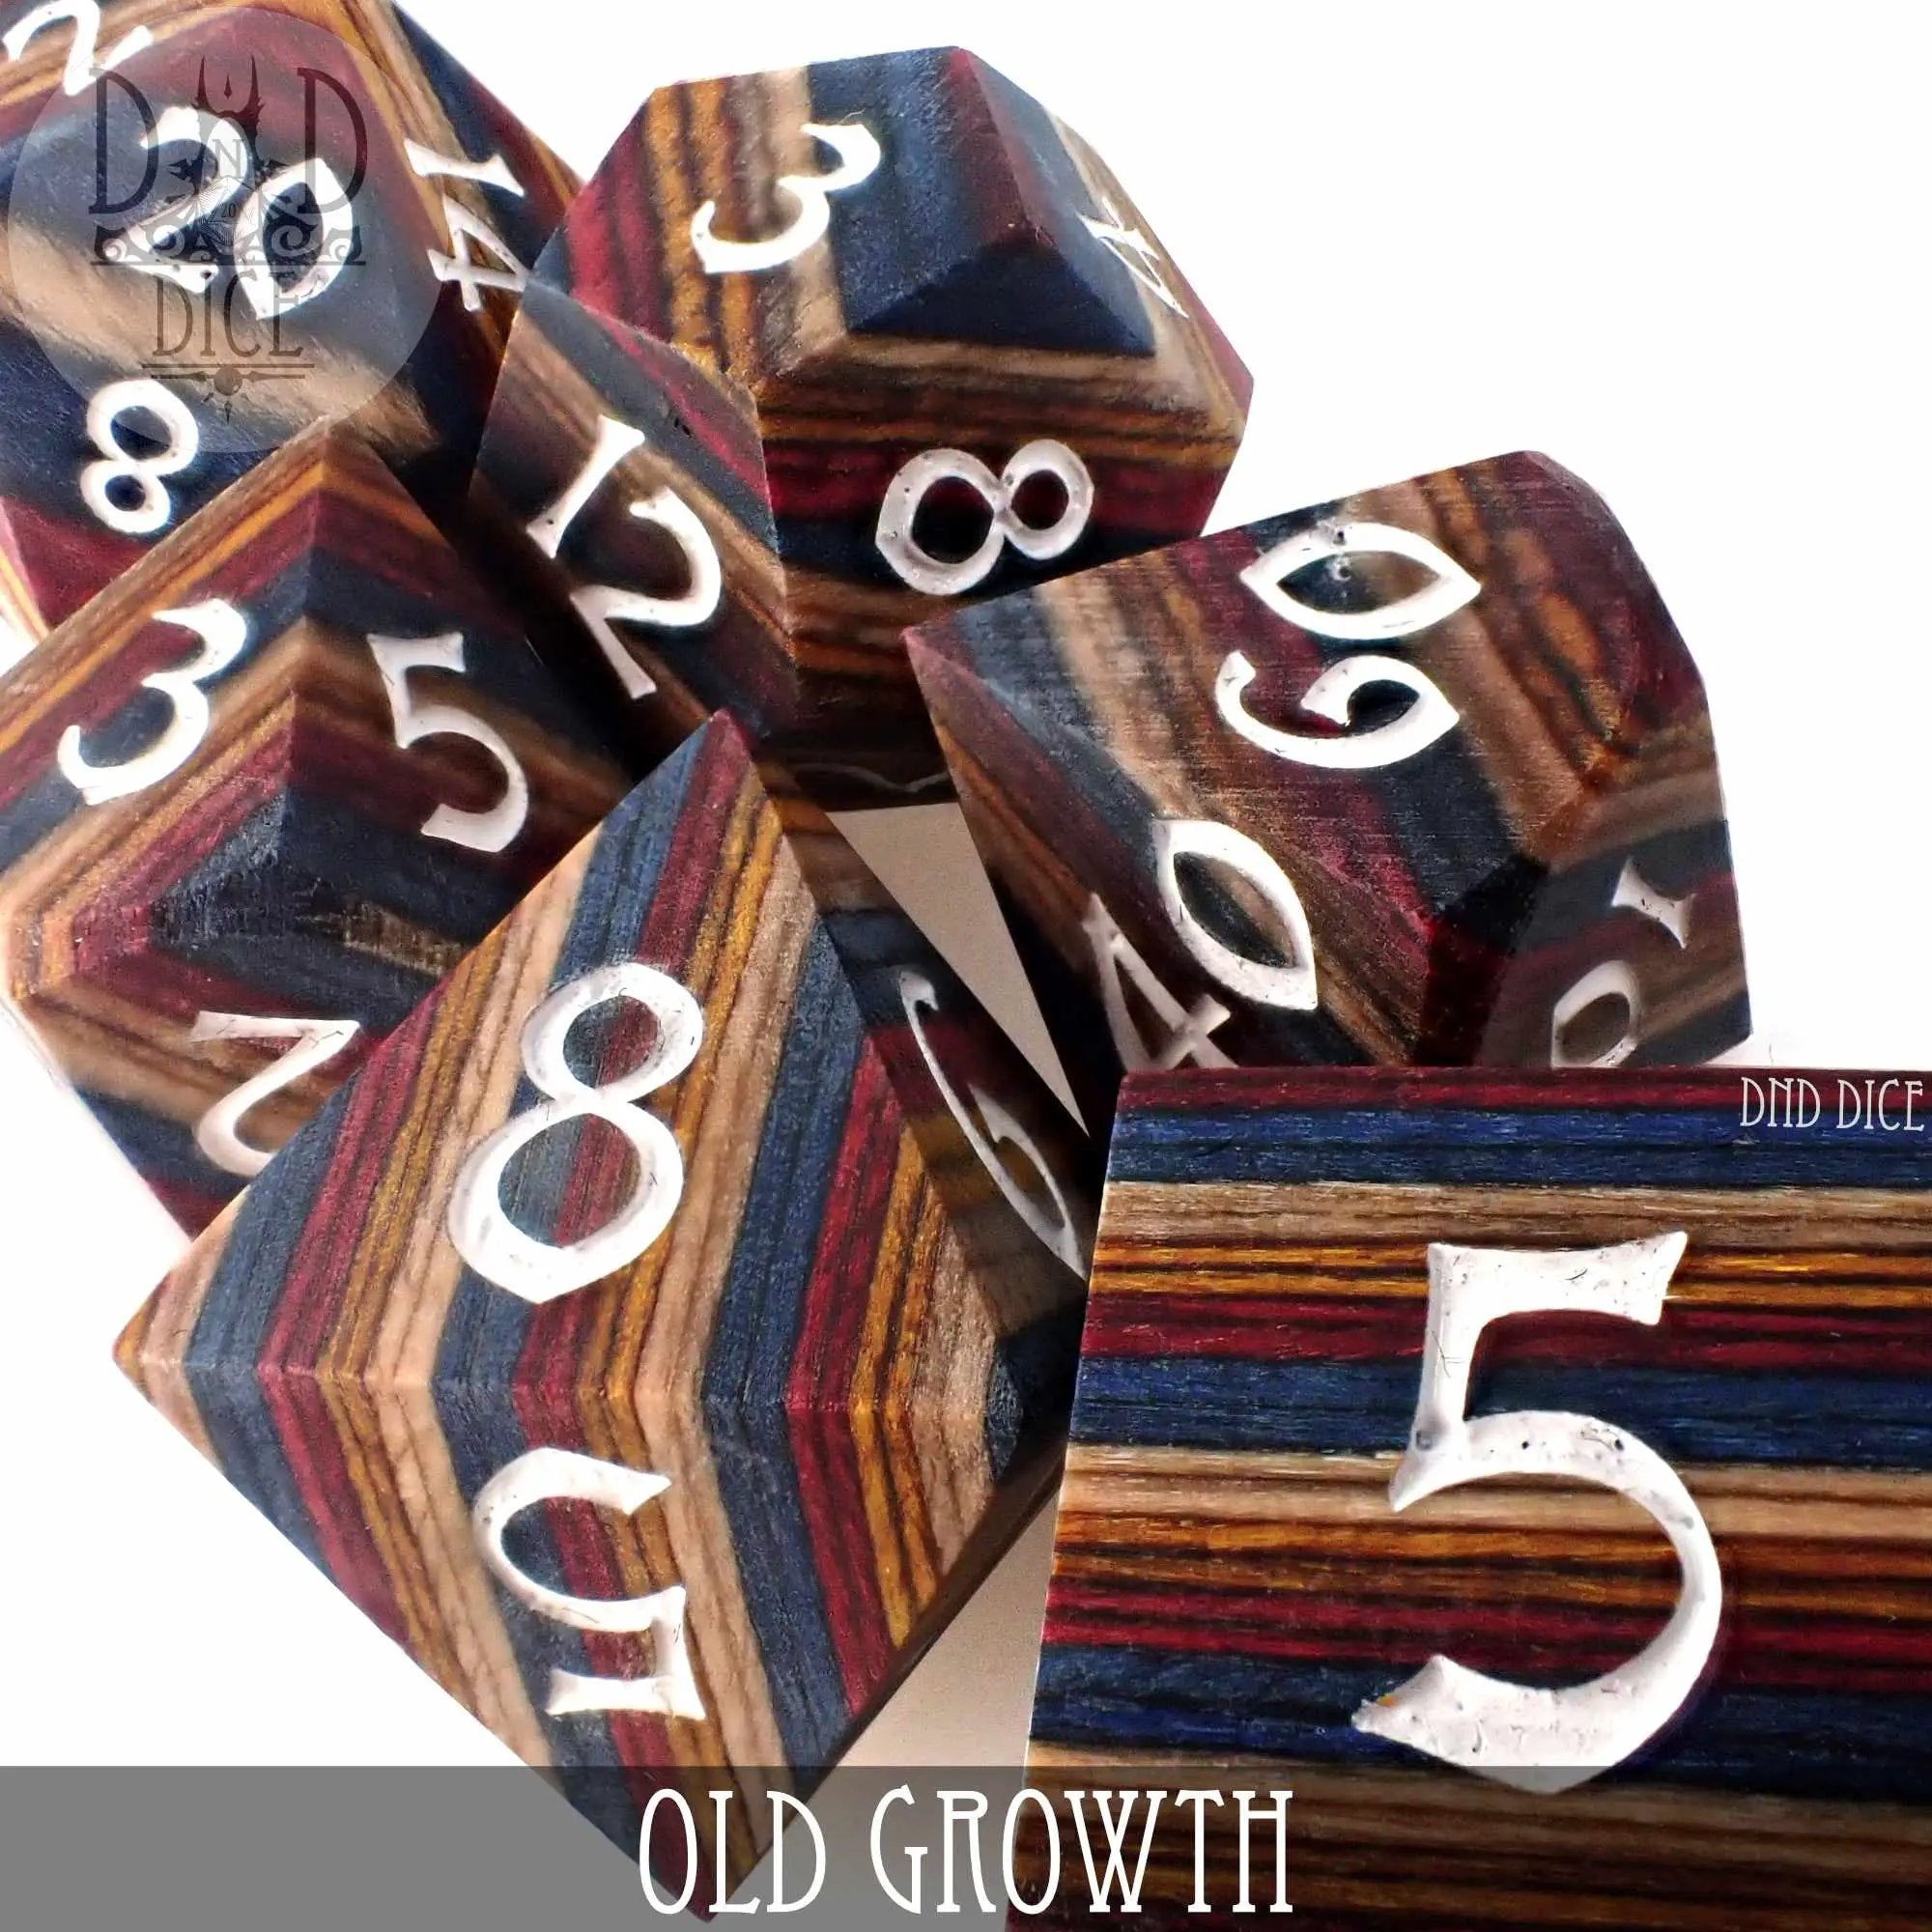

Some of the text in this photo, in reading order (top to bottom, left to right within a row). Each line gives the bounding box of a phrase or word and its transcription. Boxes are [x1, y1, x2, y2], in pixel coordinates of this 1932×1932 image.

[102, 105, 354, 320] 20
[403, 138, 527, 312] 14
[691, 124, 880, 272] 3
[80, 379, 199, 534] 8
[526, 413, 723, 699] 12
[875, 440, 1094, 595] 8
[57, 598, 247, 805] 3
[367, 632, 528, 852] 5
[447, 962, 704, 1304] 8
[899, 970, 1088, 1281] 6
[473, 1447, 706, 1720] 5
[1352, 1231, 1722, 1794] 5
